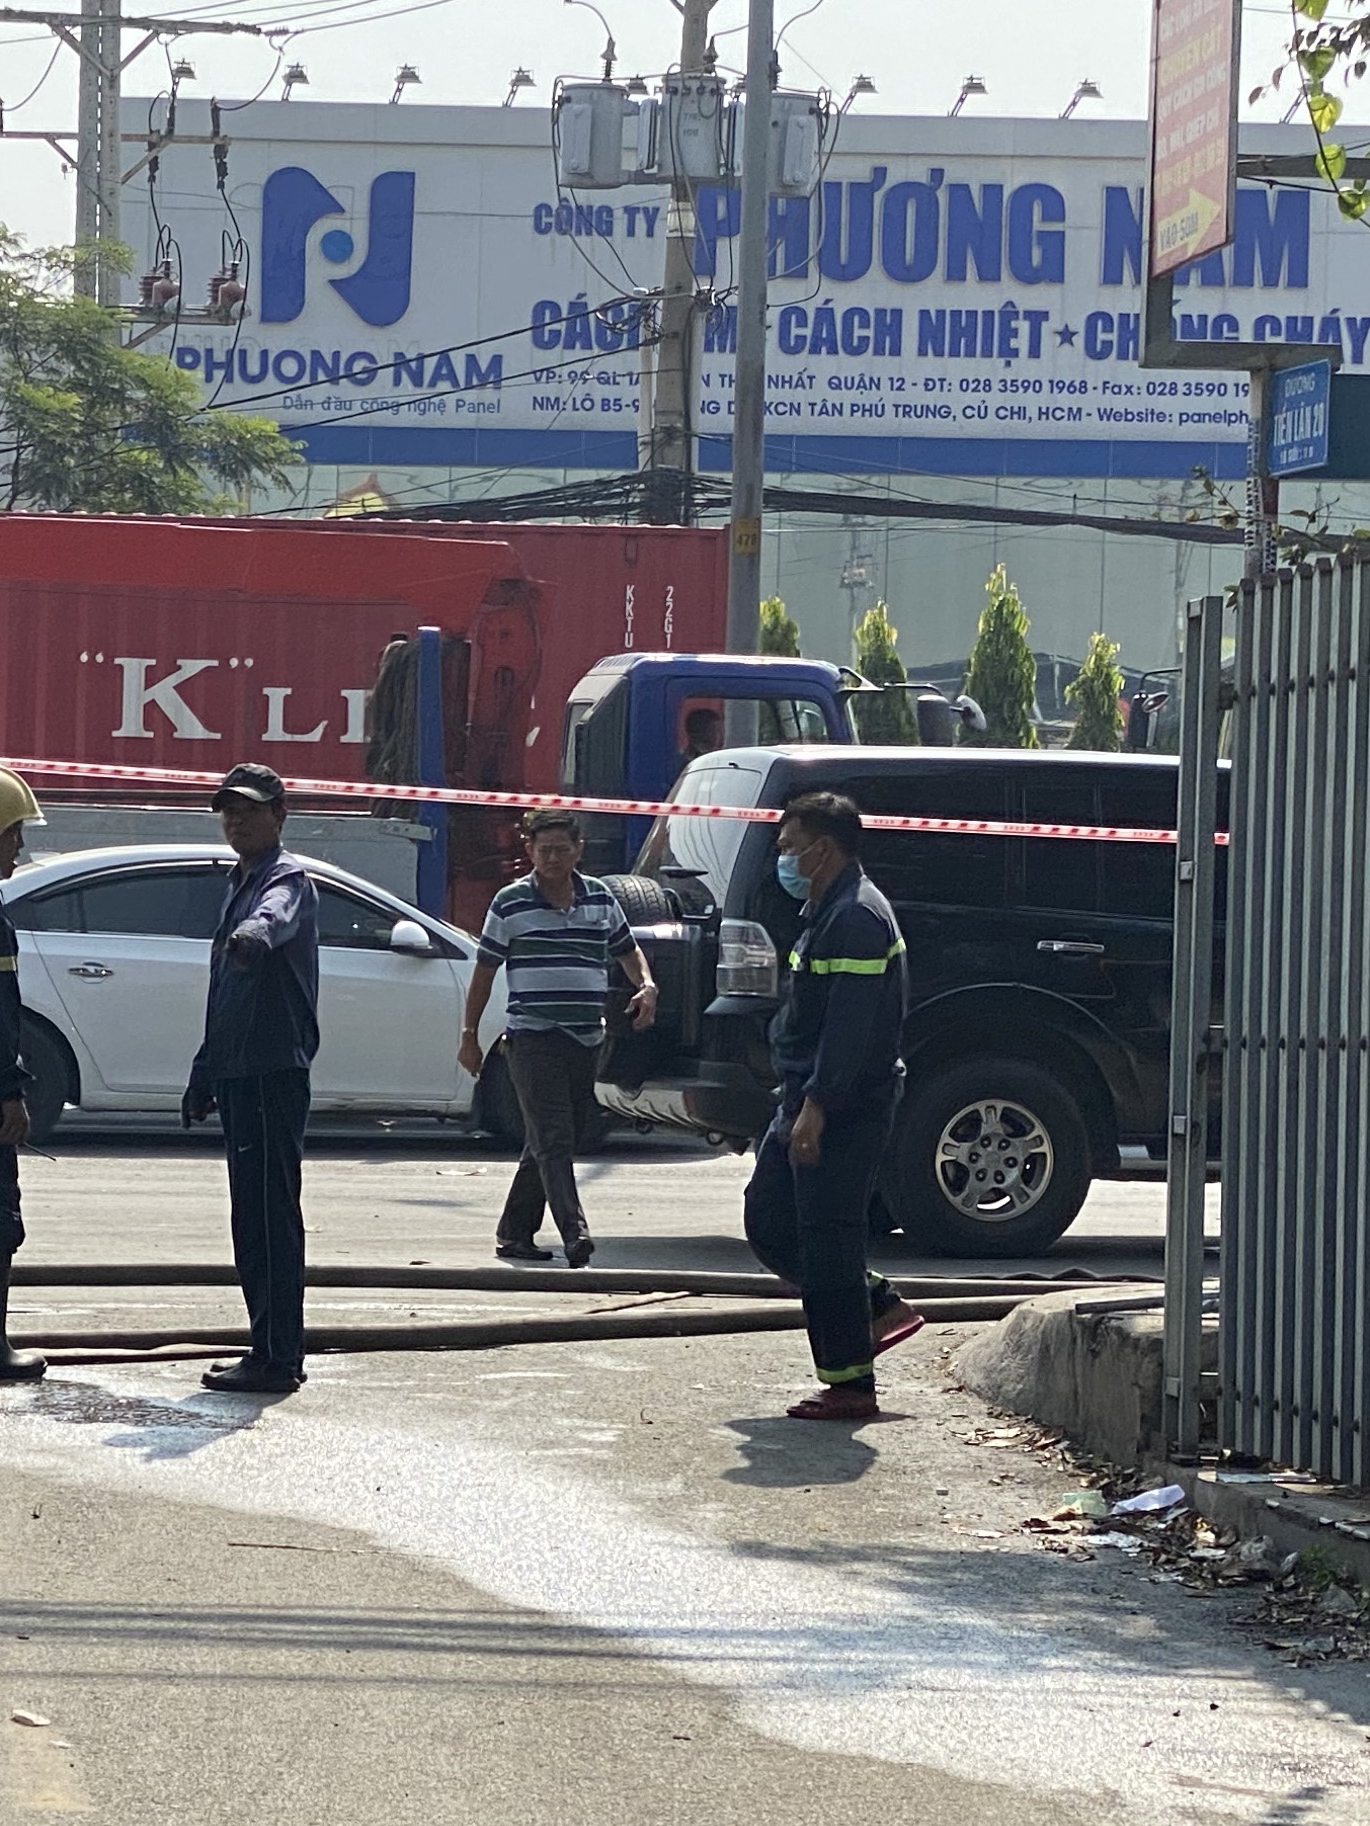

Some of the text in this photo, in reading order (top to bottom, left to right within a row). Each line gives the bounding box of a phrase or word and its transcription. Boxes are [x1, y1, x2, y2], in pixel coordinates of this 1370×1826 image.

[533, 197, 614, 236] CÔNG
[623, 206, 660, 238] TY
[778, 299, 903, 357] CÁCH
[917, 301, 1049, 368] NHIỆT
[176, 347, 503, 390] PHUONG NAM
[768, 368, 816, 390] NHẤT
[828, 373, 881, 395] QUẬN
[888, 377, 906, 392] 12
[923, 378, 952, 393] ĐT:
[960, 378, 992, 393] 028
[998, 379, 1043, 394] 3590
[1048, 379, 1089, 395] 1968
[1146, 381, 1178, 396] 028
[1182, 382, 1228, 397] 3590
[455, 398, 501, 414] Panel
[532, 396, 566, 412] NM:
[572, 393, 595, 412] LÔ
[808, 398, 844, 417] TÂN
[850, 397, 886, 418] PHÚ
[892, 403, 956, 422] TRUNG,
[962, 399, 988, 420] CỦ
[995, 405, 1032, 424] CHI,
[1038, 406, 1083, 422] HCM
[1097, 407, 1173, 423] Website:
[1178, 409, 1249, 427] panelph
